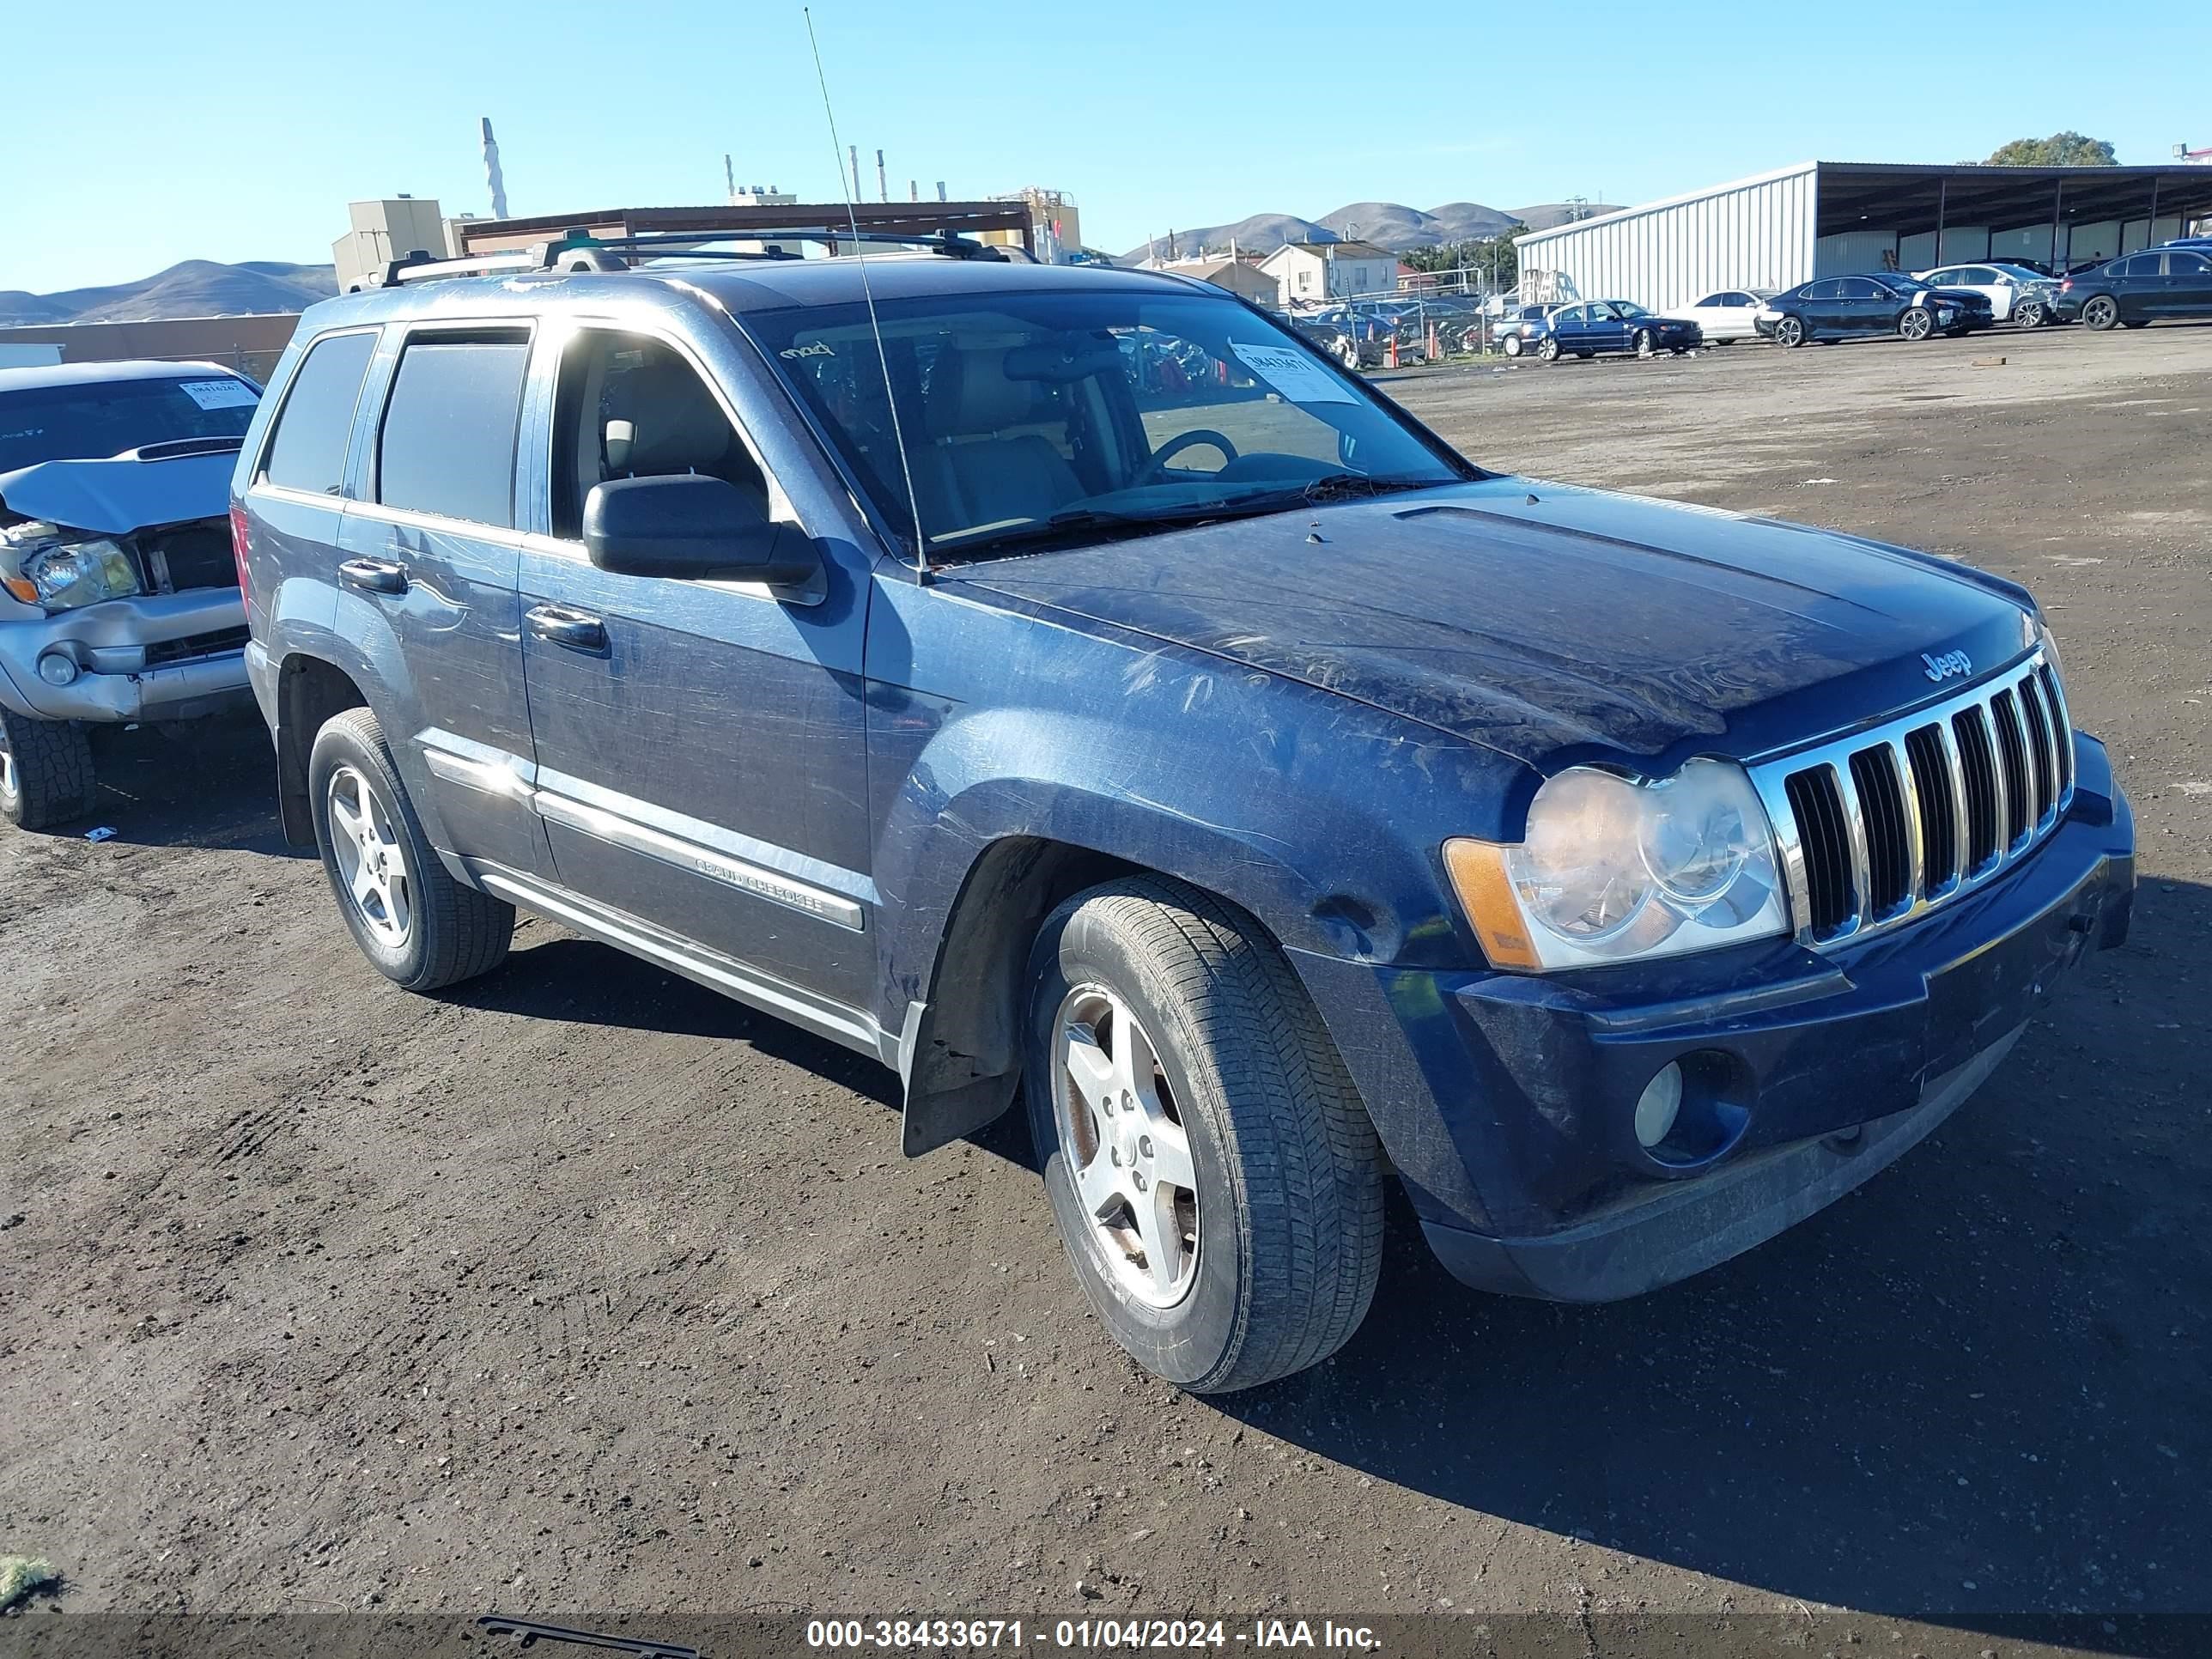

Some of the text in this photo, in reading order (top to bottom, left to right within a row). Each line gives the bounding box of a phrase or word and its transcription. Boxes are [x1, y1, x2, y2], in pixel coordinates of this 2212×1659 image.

[1246, 356, 1312, 371] 38433671
[1920, 649, 1972, 682] Jeep
[695, 858, 823, 912] GRAND CHEROKEE
